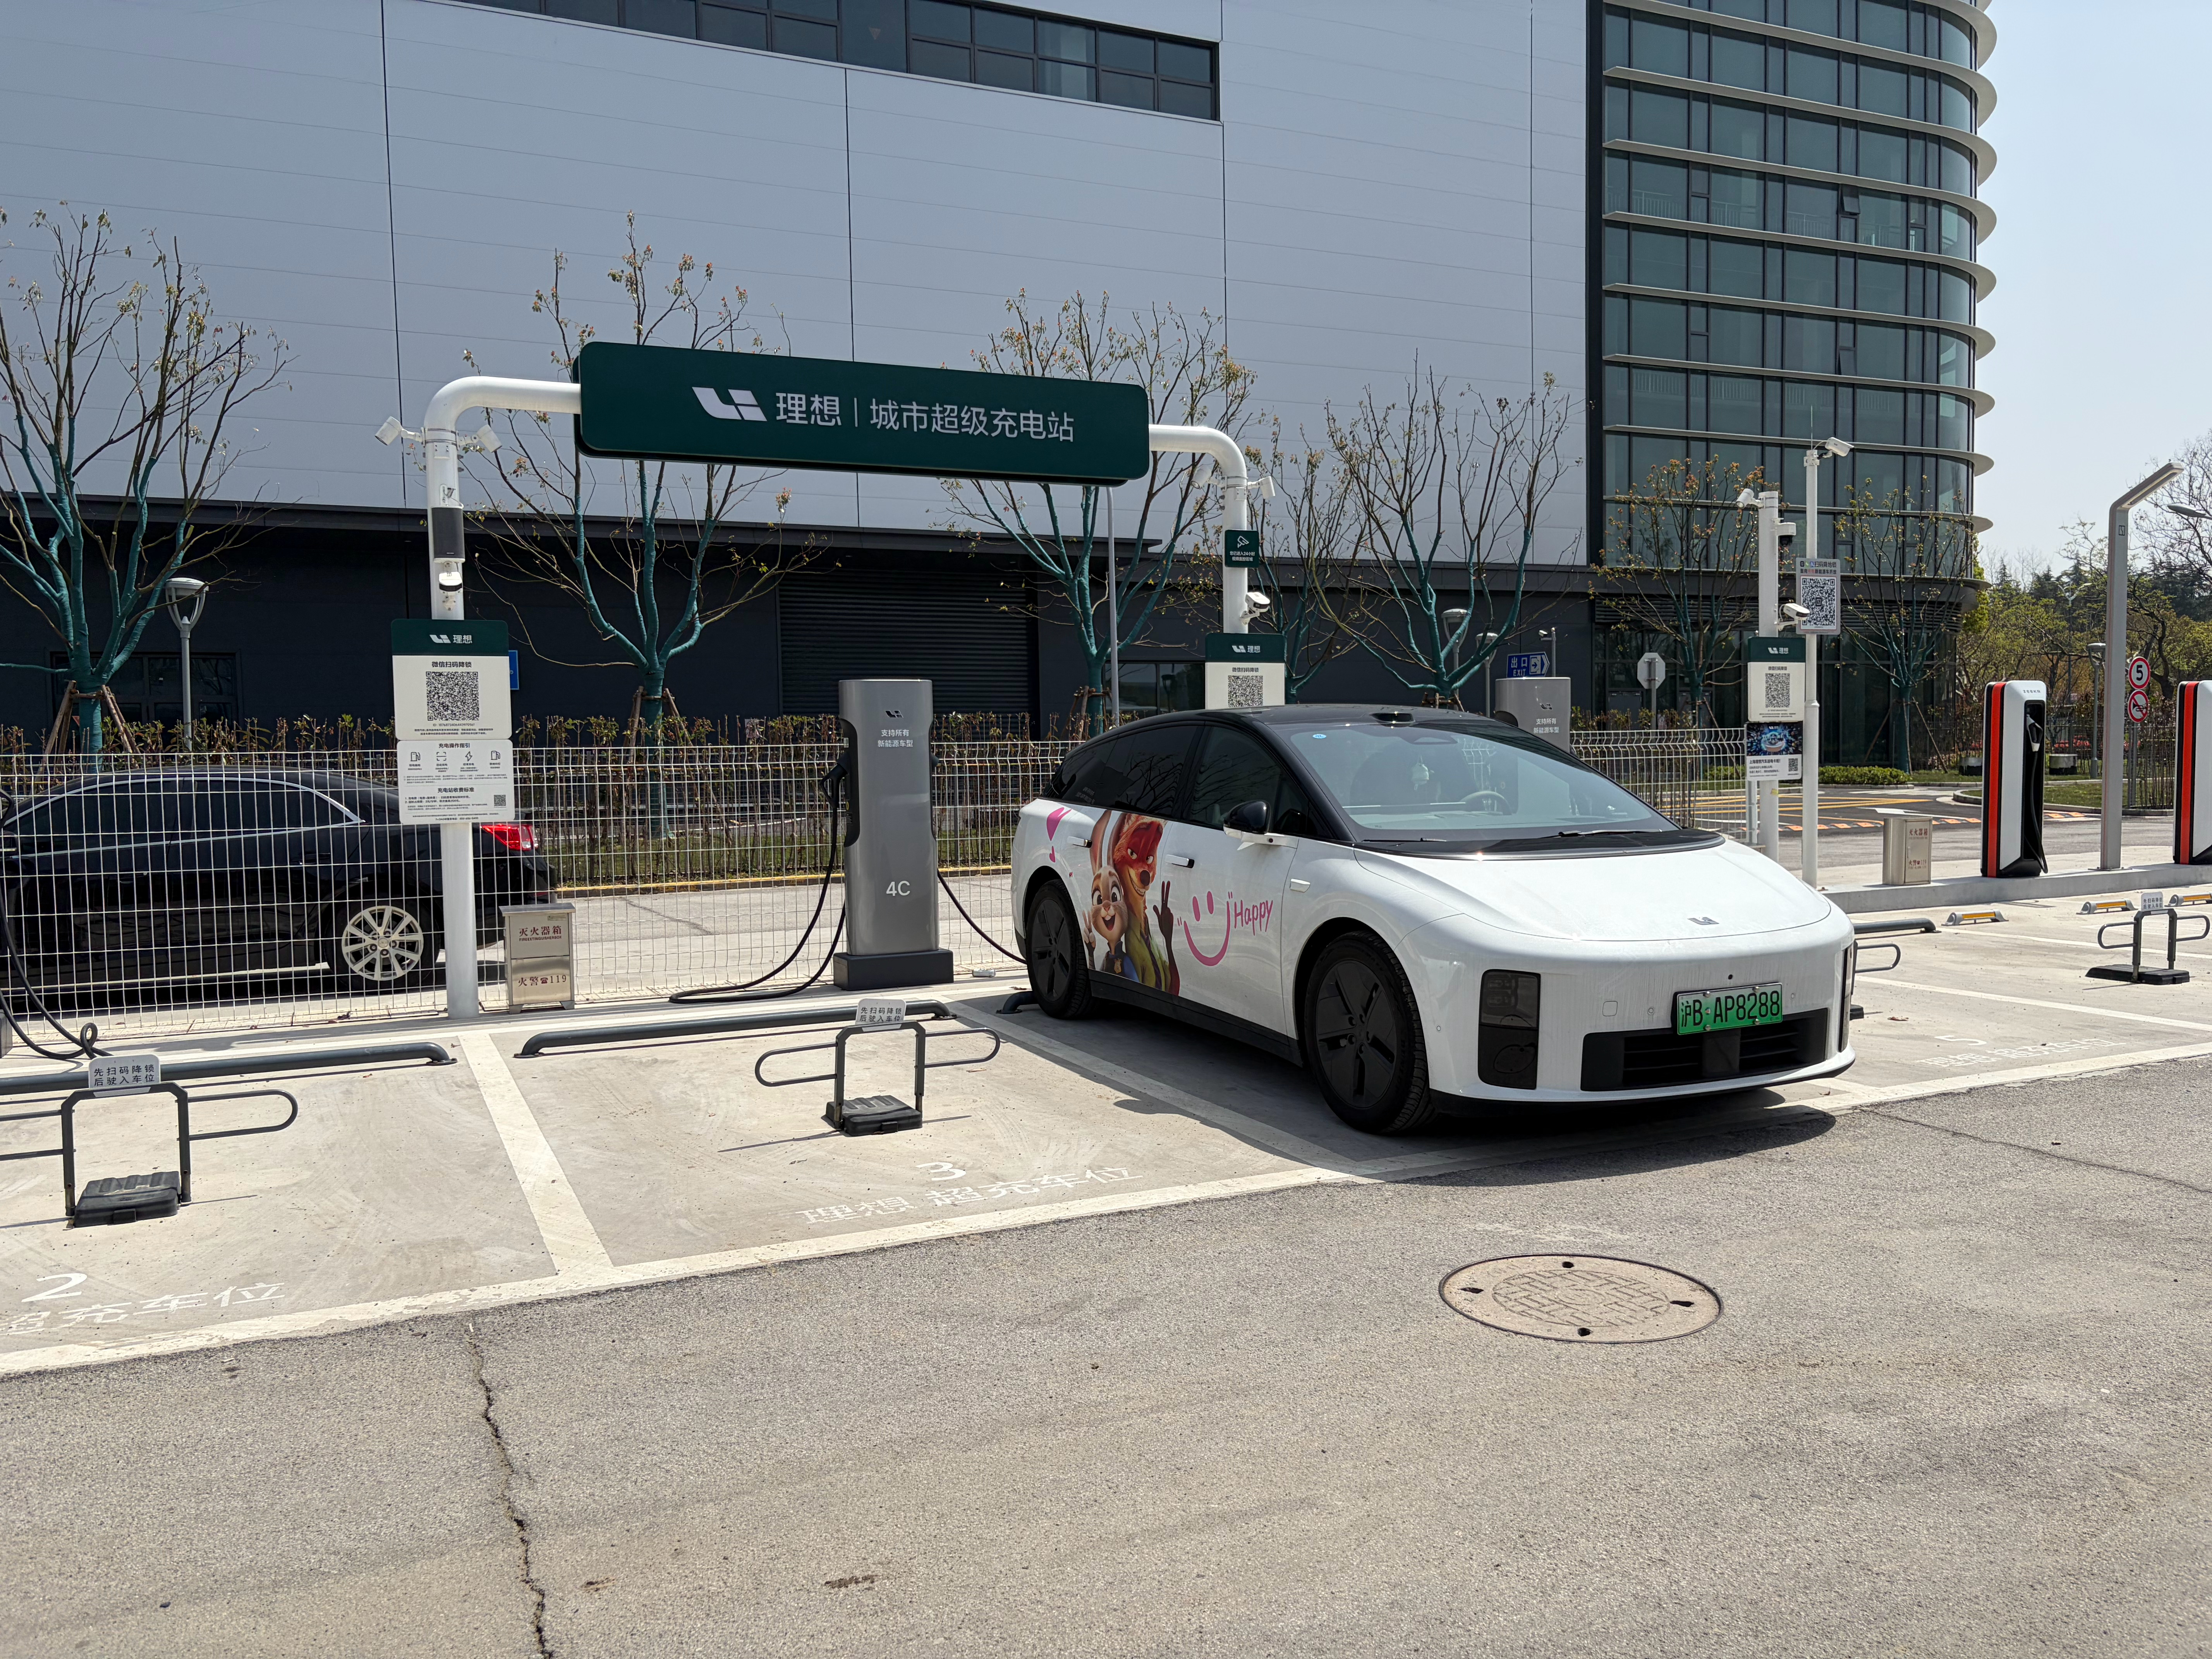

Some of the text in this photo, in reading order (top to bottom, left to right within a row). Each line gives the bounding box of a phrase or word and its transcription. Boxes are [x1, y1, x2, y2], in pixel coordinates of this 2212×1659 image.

[776, 392, 1074, 442] 理想 城市超级充电站
[453, 635, 472, 644] 理想
[1511, 656, 1528, 668] 出口
[2136, 665, 2143, 681] 5
[886, 880, 910, 896] 4C
[1234, 900, 1273, 936] Happy
[519, 926, 562, 937] 灭火器箱
[518, 974, 567, 987] 火警 119
[1934, 1035, 1987, 1046] 5
[94, 1064, 155, 1077] 先扫码降锁
[94, 1074, 155, 1086] 后驶入车位
[915, 1161, 967, 1181] 3
[795, 1167, 1144, 1224] 理想 超充车位
[21, 1273, 88, 1302] 2
